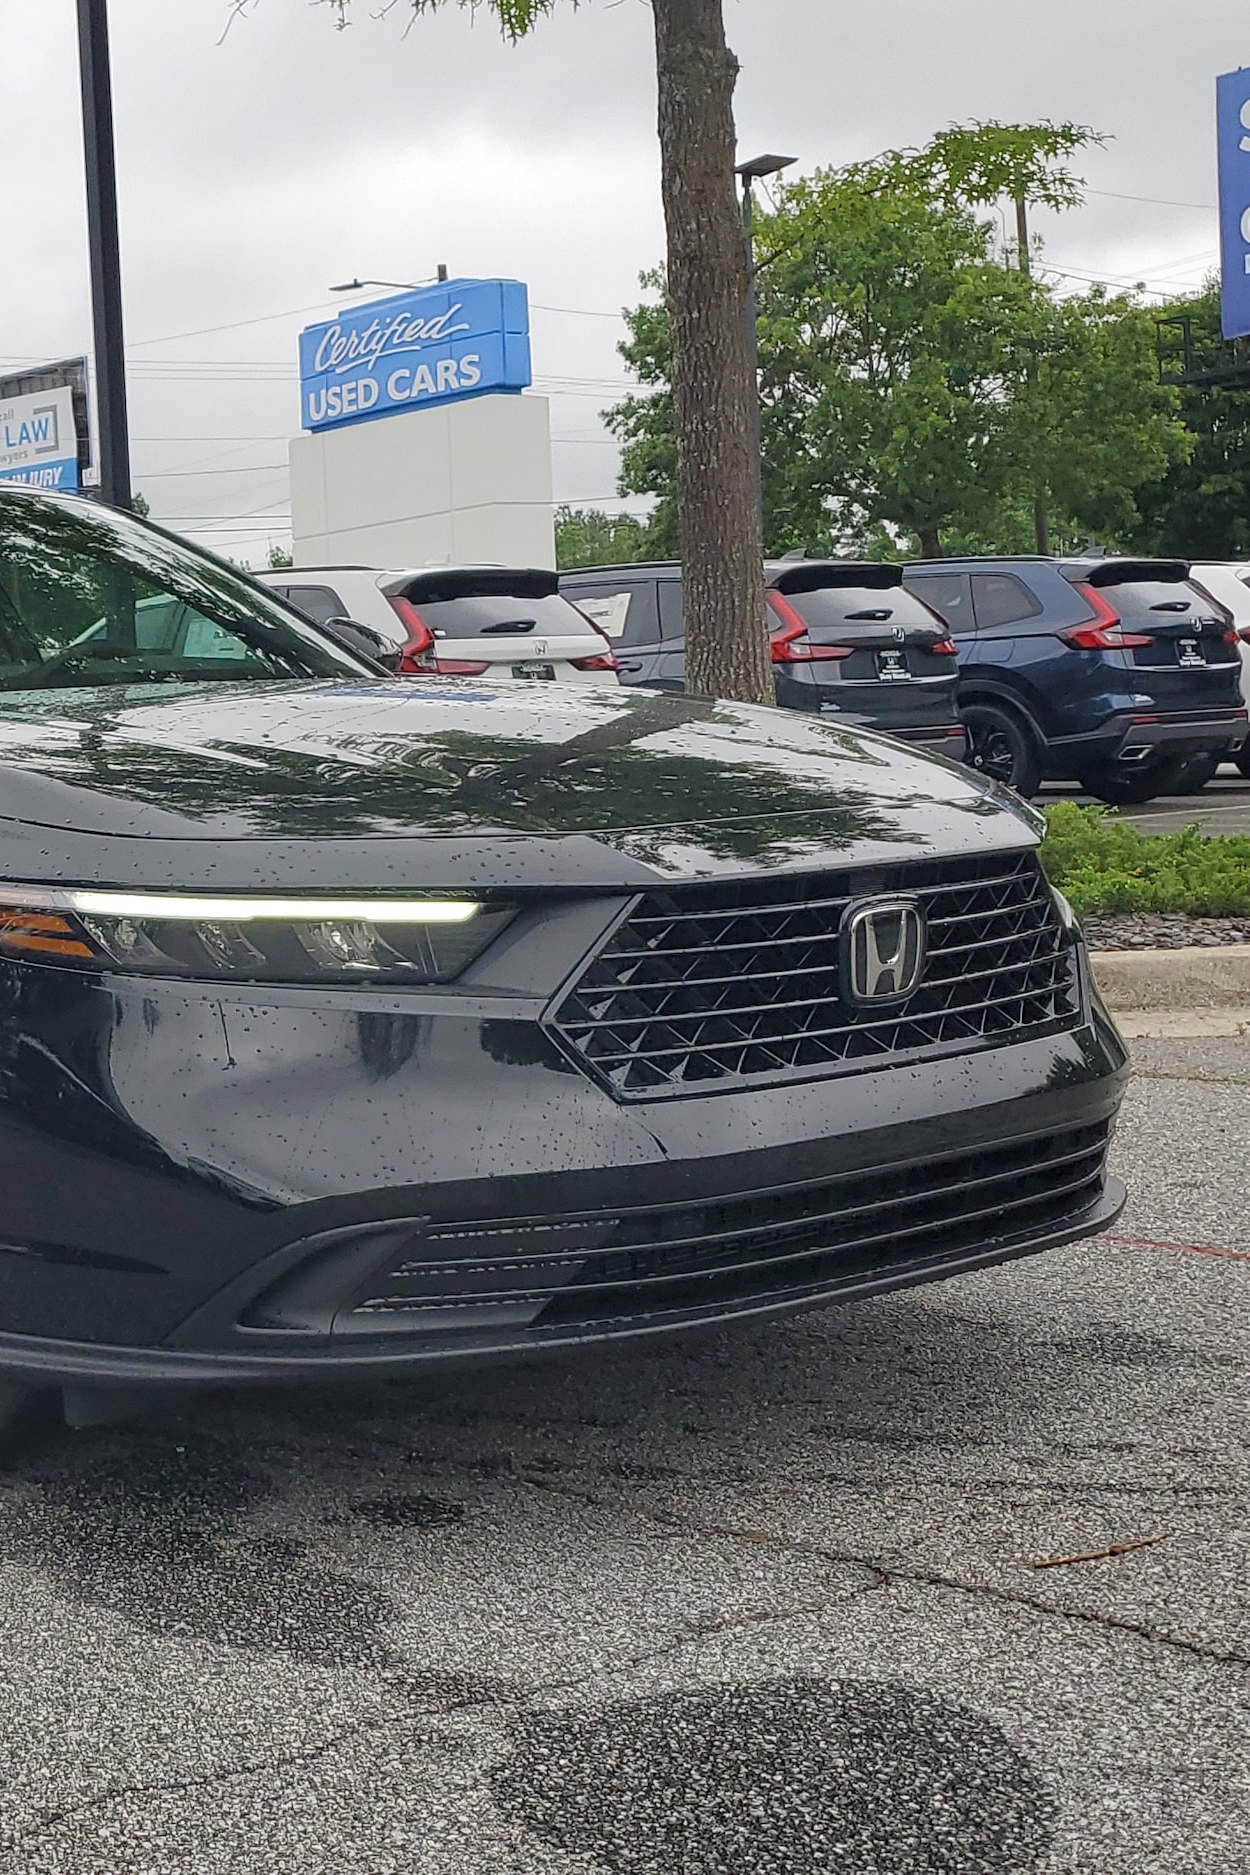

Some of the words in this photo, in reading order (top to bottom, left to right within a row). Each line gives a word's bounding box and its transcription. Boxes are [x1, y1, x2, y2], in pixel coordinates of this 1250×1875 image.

[314, 303, 470, 374] Certified
[308, 377, 379, 421] USED
[387, 354, 481, 402] CARS
[5, 417, 49, 448] LAW
